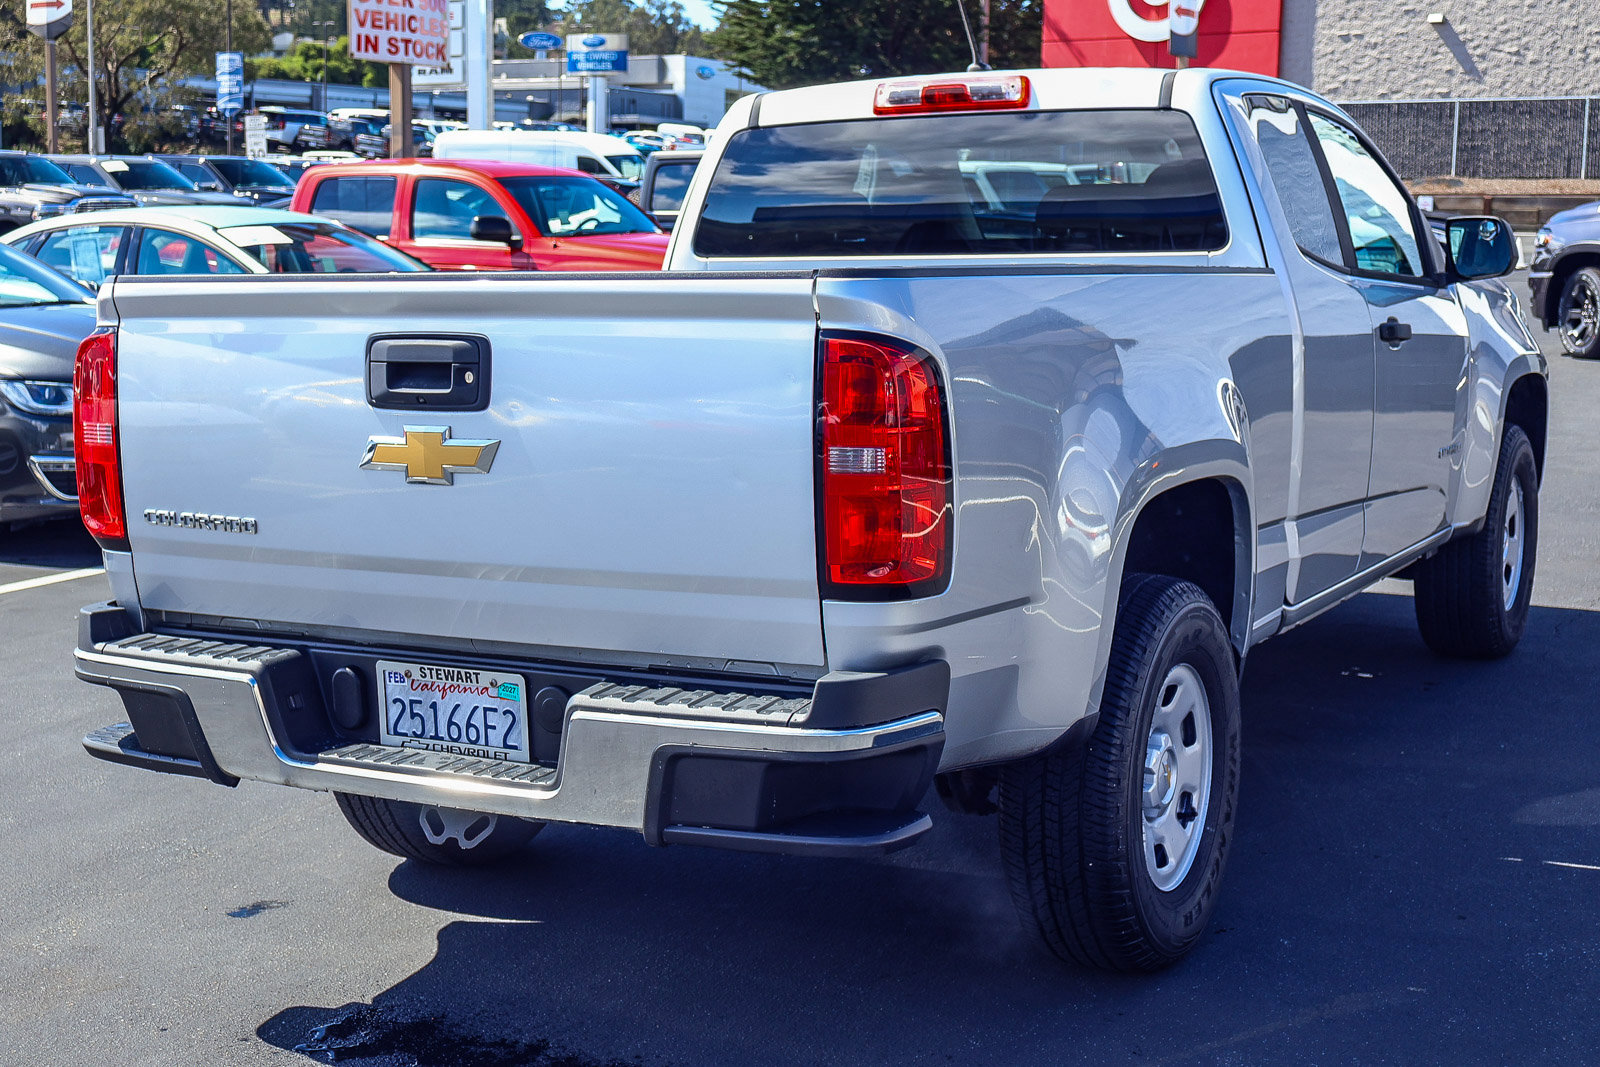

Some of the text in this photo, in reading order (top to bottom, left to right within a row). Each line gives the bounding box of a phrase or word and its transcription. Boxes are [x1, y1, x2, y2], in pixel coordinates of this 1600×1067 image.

[354, 8, 449, 39] VEHICLES
[356, 34, 447, 62] IN STOCK
[143, 508, 258, 535] COLORADO
[388, 671, 406, 684] FEB
[419, 666, 481, 684] STEWART
[410, 678, 498, 700] California
[502, 684, 516, 694] 2027
[392, 697, 519, 750] 25166F2
[432, 744, 510, 761] CHEVROLET
